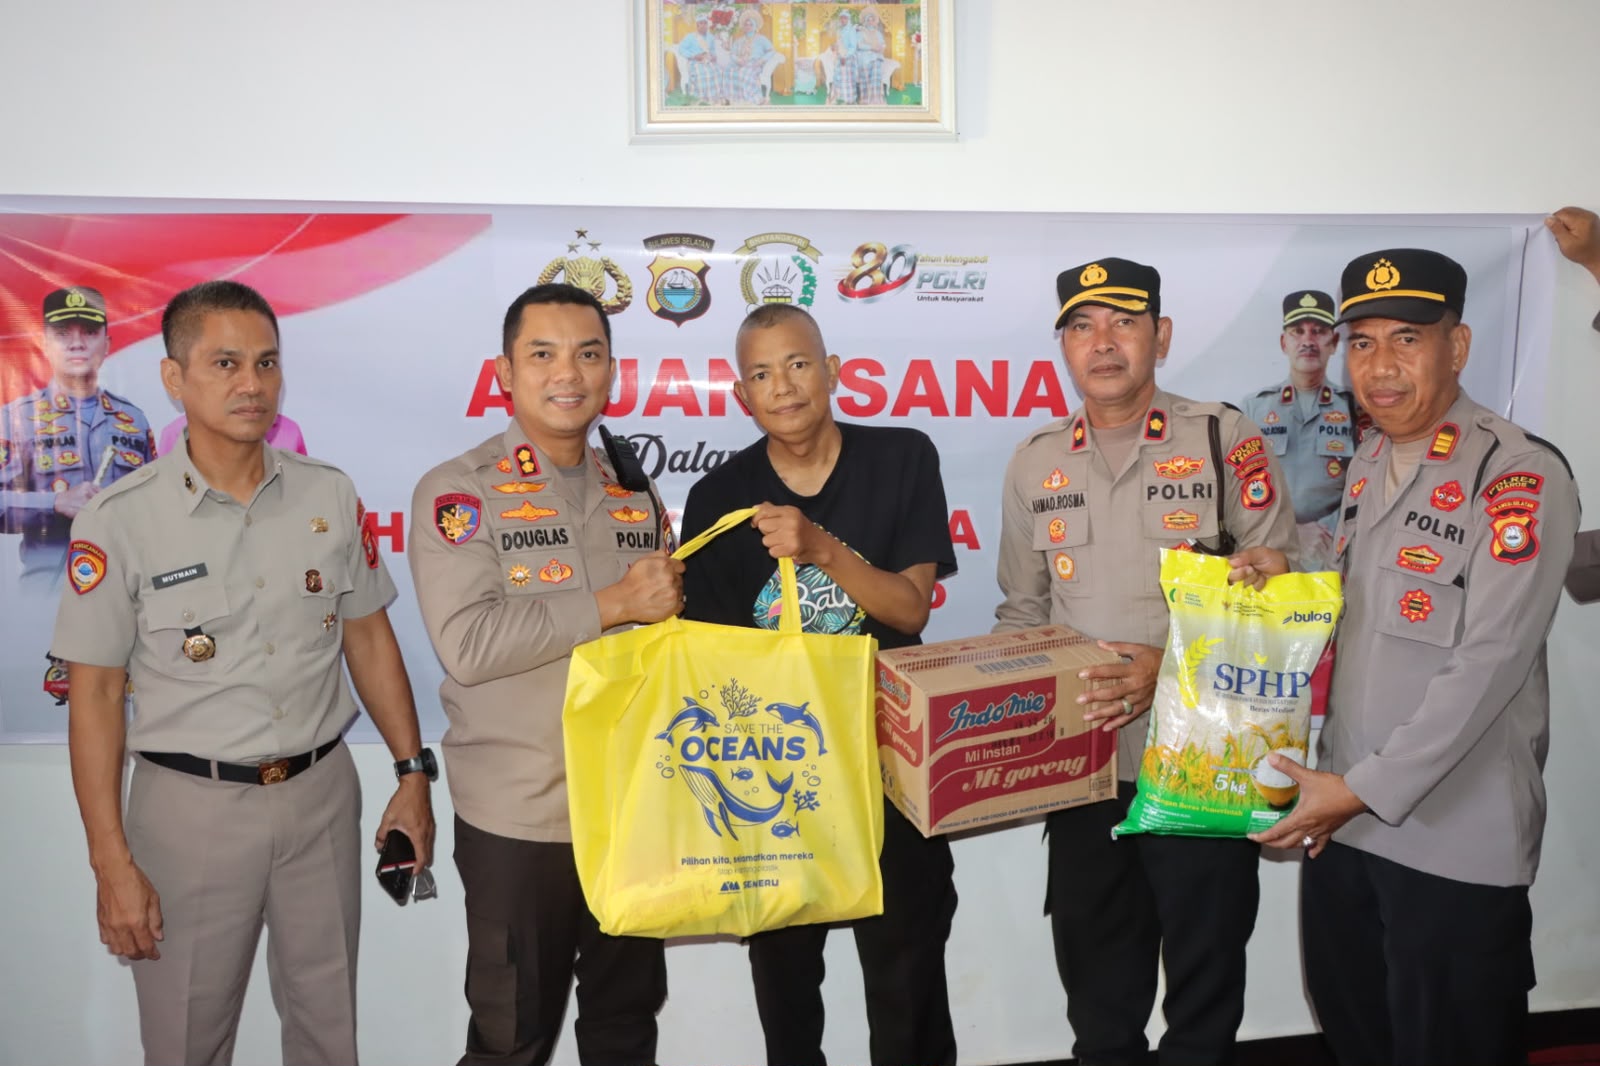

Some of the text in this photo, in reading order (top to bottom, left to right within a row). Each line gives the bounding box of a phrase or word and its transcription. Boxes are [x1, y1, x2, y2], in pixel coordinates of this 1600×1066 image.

[915, 271, 989, 290] POLRI
[916, 295, 985, 304] Untuk Masyarakat
[628, 432, 740, 480] Dala
[1147, 483, 1212, 501] POLRI
[1031, 493, 1086, 515] AHMAD.ROSMA
[1404, 510, 1466, 545] POLRI
[501, 527, 569, 551] DOUGLAS
[616, 531, 654, 549] POLRI
[161, 568, 198, 583] MUTMAIN
[1293, 611, 1332, 624] bulog
[1213, 663, 1311, 698] SPHP
[724, 722, 783, 734] SAVE THE
[680, 736, 806, 762] OCEANS
[965, 744, 1021, 764] Mi Instan
[962, 766, 1000, 793] Mi
[1002, 755, 1087, 789] goreng
[1214, 773, 1248, 796] 5 kg
[779, 852, 814, 861] mereka
